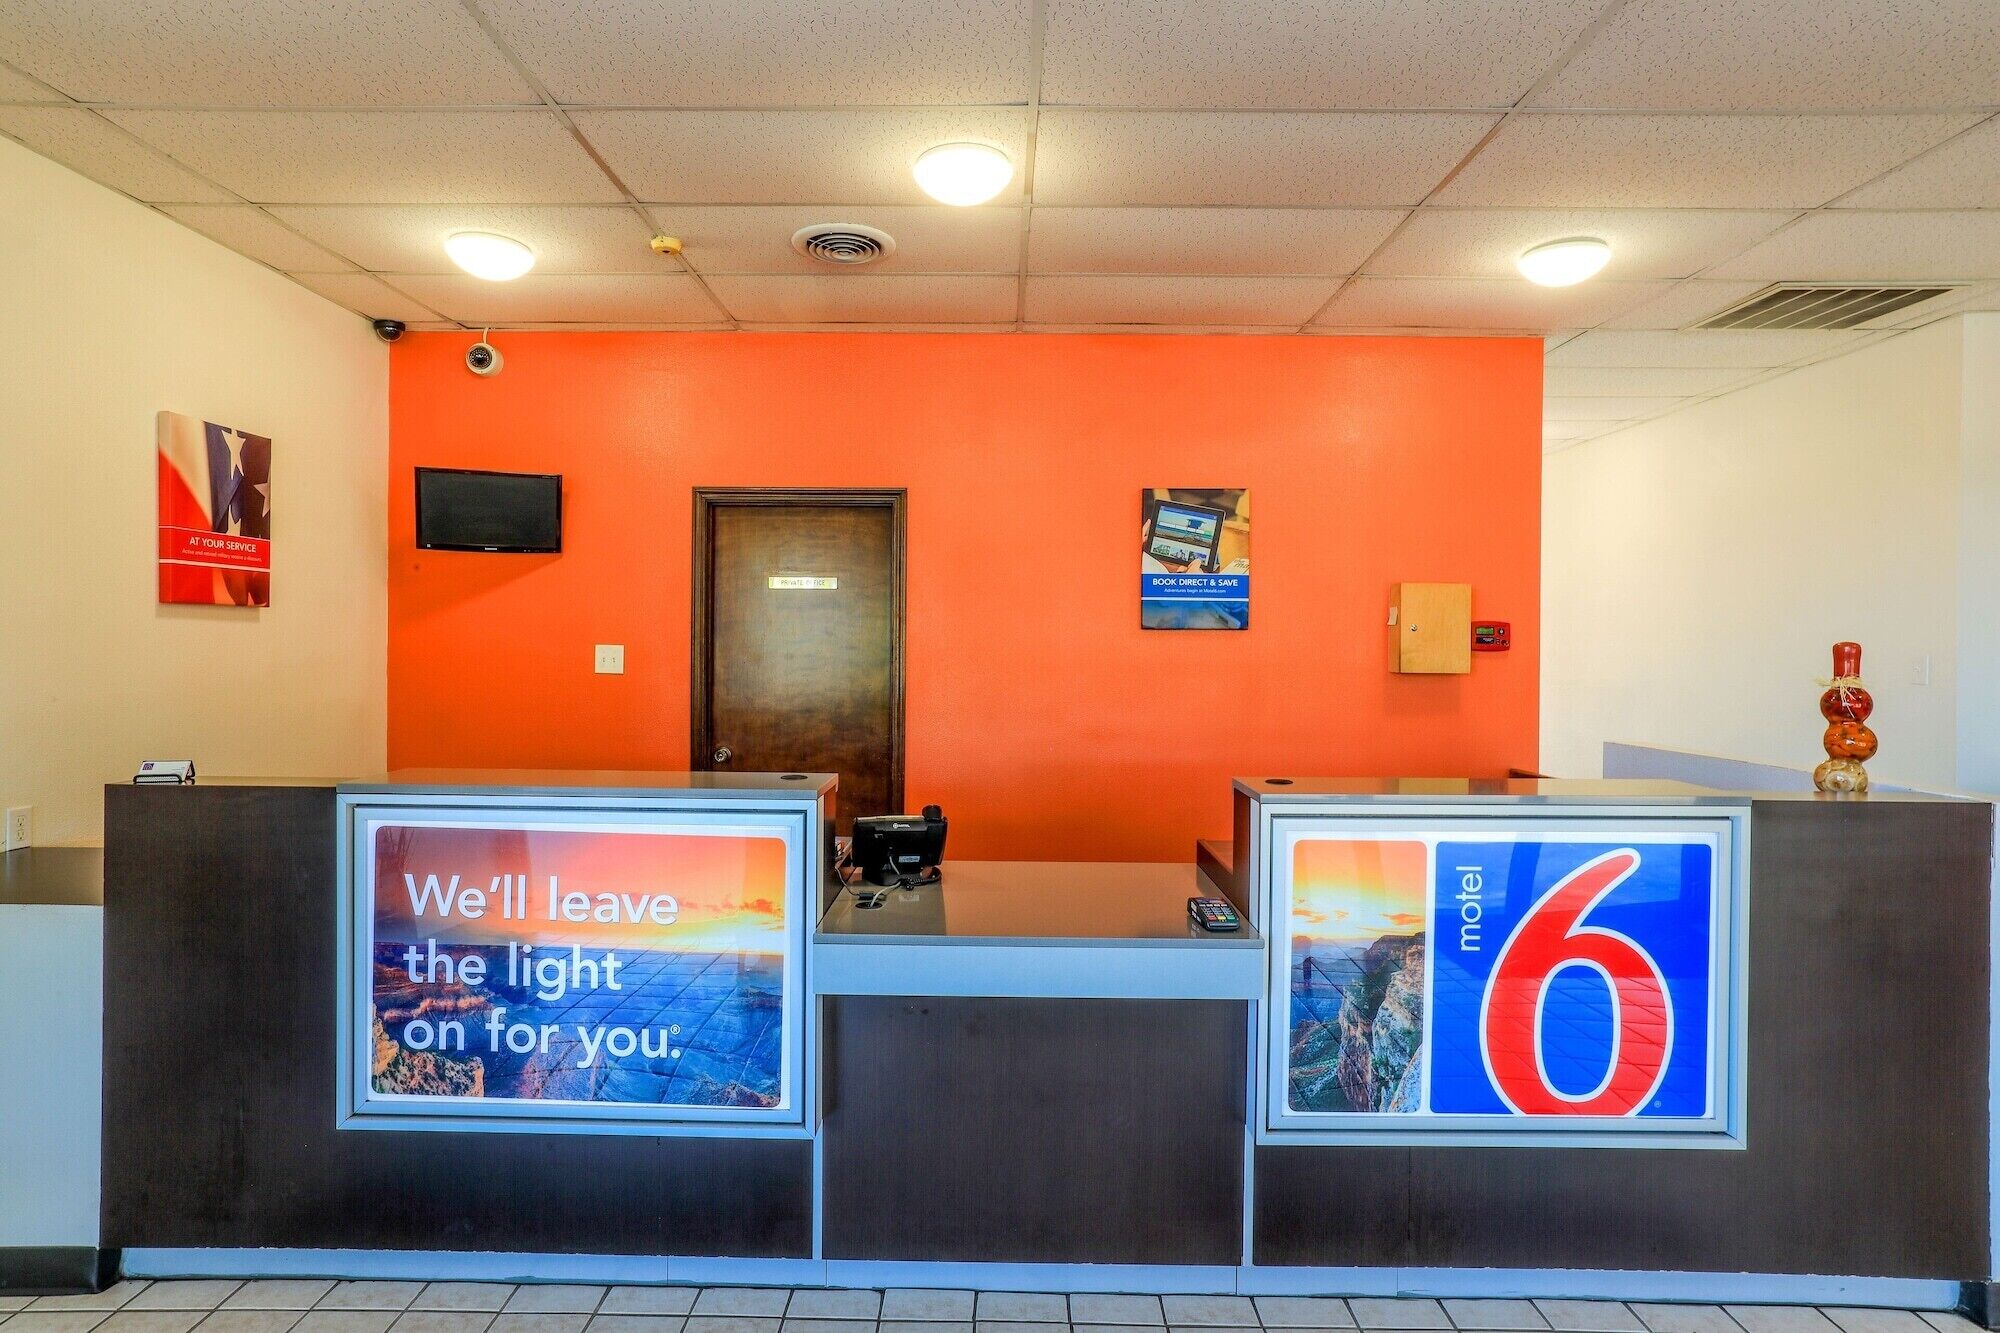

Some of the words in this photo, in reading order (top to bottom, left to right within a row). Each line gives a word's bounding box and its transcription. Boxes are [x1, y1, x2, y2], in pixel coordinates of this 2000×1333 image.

[189, 537, 200, 546] AT
[202, 537, 225, 549] YOUR
[226, 541, 257, 553] SERVICE
[1152, 578, 1177, 586] BOOK
[1179, 578, 1208, 586] DIRECT
[1218, 579, 1238, 587] SAVE
[404, 873, 526, 920] We'll
[549, 875, 679, 924] leave
[1456, 866, 1483, 952] motel
[403, 939, 486, 986] the
[509, 941, 622, 1001] light
[1478, 847, 1674, 1117] 6
[403, 1017, 465, 1051] on
[485, 1007, 560, 1054] for
